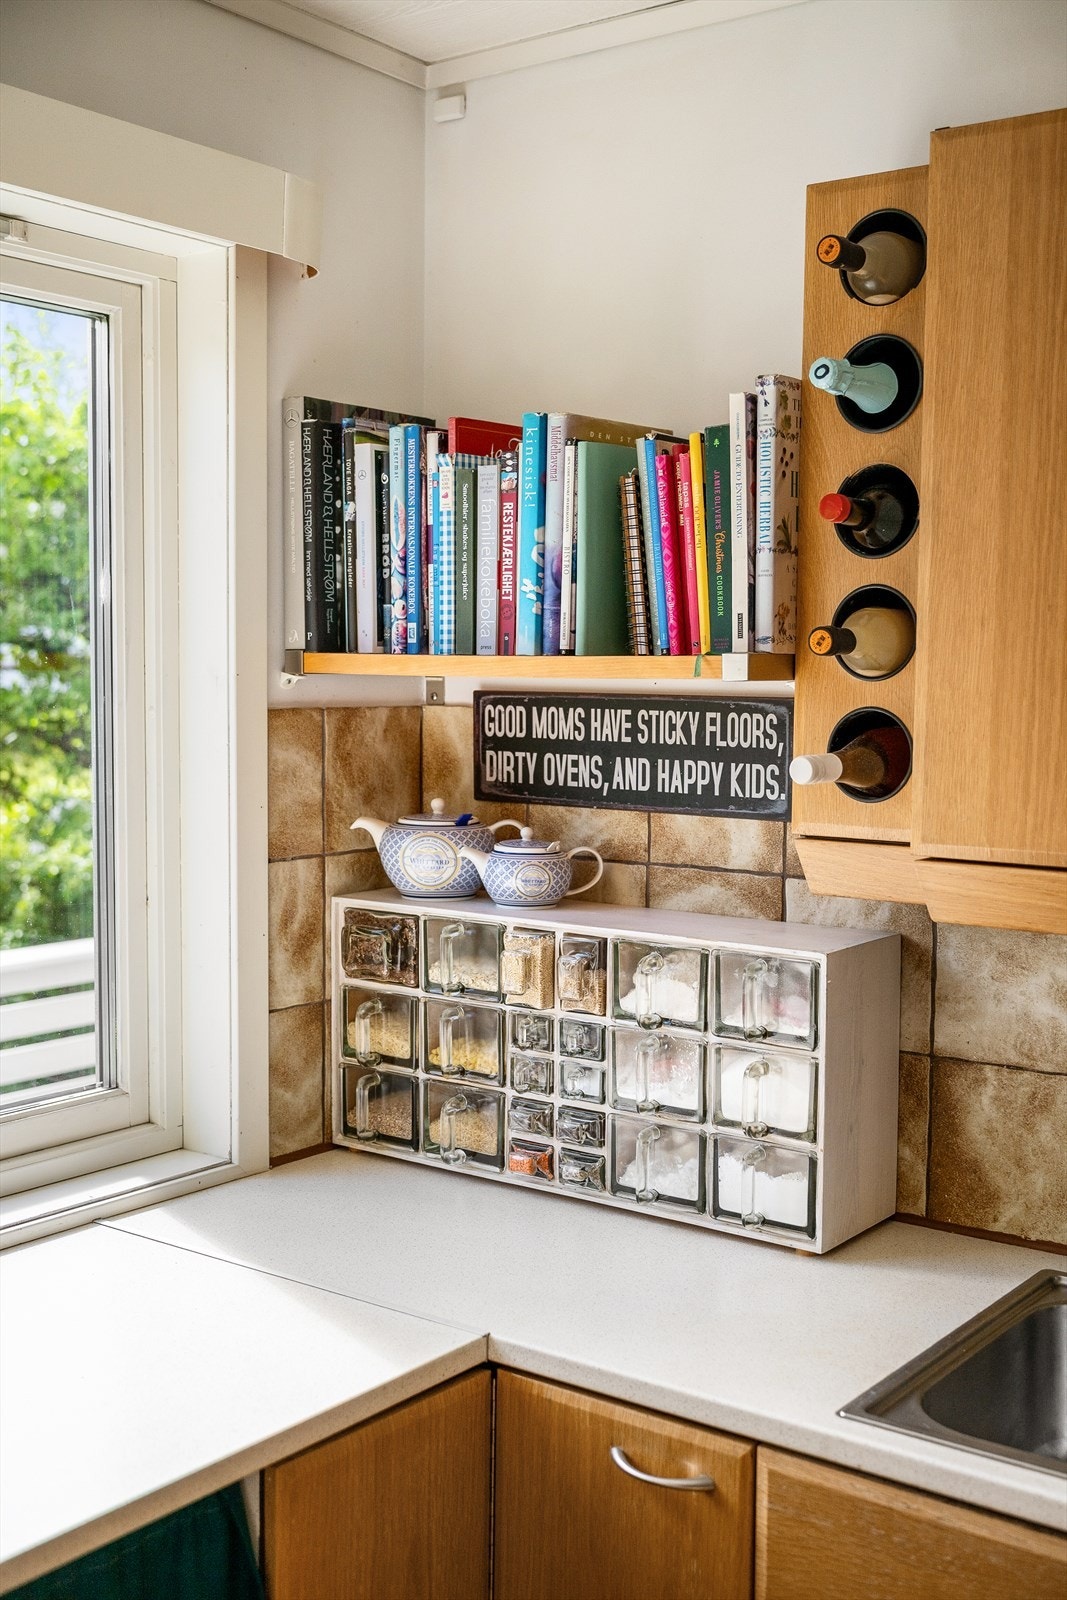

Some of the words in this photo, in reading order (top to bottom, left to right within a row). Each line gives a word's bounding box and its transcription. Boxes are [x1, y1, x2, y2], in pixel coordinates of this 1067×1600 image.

[302, 427, 312, 477] HÆRLAND
[549, 425, 562, 482] Middelhavsmat
[589, 431, 612, 440] DEN
[735, 444, 743, 470] GUIDE
[288, 439, 296, 494] BAGATELLE
[303, 477, 312, 486] &
[322, 428, 334, 504] HÆRLAND
[345, 458, 353, 476] TOVE
[407, 438, 416, 506] MESTERKOKKENS
[524, 427, 538, 508] kinesisk!
[713, 470, 721, 495] JAMIE
[735, 471, 743, 481] TO
[759, 440, 772, 497] HOLISTIC
[303, 486, 313, 543] HELLSTRØM
[322, 505, 334, 517] &
[657, 481, 668, 527] thailandsk
[682, 481, 690, 509] tapas
[714, 495, 722, 530] OLIVER'S
[735, 482, 743, 539] ENTERTAINING
[408, 507, 416, 575] INTERNASJONALE
[759, 501, 771, 547] HERBAL
[305, 561, 313, 577] med
[322, 518, 336, 602] HELLSTRØM
[346, 556, 354, 588] matgleder
[381, 533, 391, 579] BRØD
[462, 551, 469, 561] og
[480, 498, 497, 638] familiekokeboka
[502, 502, 514, 602] RESTEKJÆRLIGHET
[563, 546, 571, 576] BISTRO
[653, 542, 663, 582] TRATTORIA
[714, 530, 727, 574] Christmas
[408, 577, 416, 615] KOKEBOK
[716, 575, 724, 617] COOKBOOK
[484, 704, 527, 738] GOOD
[531, 706, 586, 742] MOMS
[590, 708, 632, 743] HAVE
[637, 709, 700, 746] STICKY
[705, 711, 784, 757] FLOORS,
[485, 750, 537, 785] DIRTY
[543, 752, 609, 796] OVENS,
[612, 756, 650, 792] AND
[657, 758, 724, 797] HAPPY
[730, 762, 786, 800] KIDS.
[410, 857, 450, 866] WHITTARD
